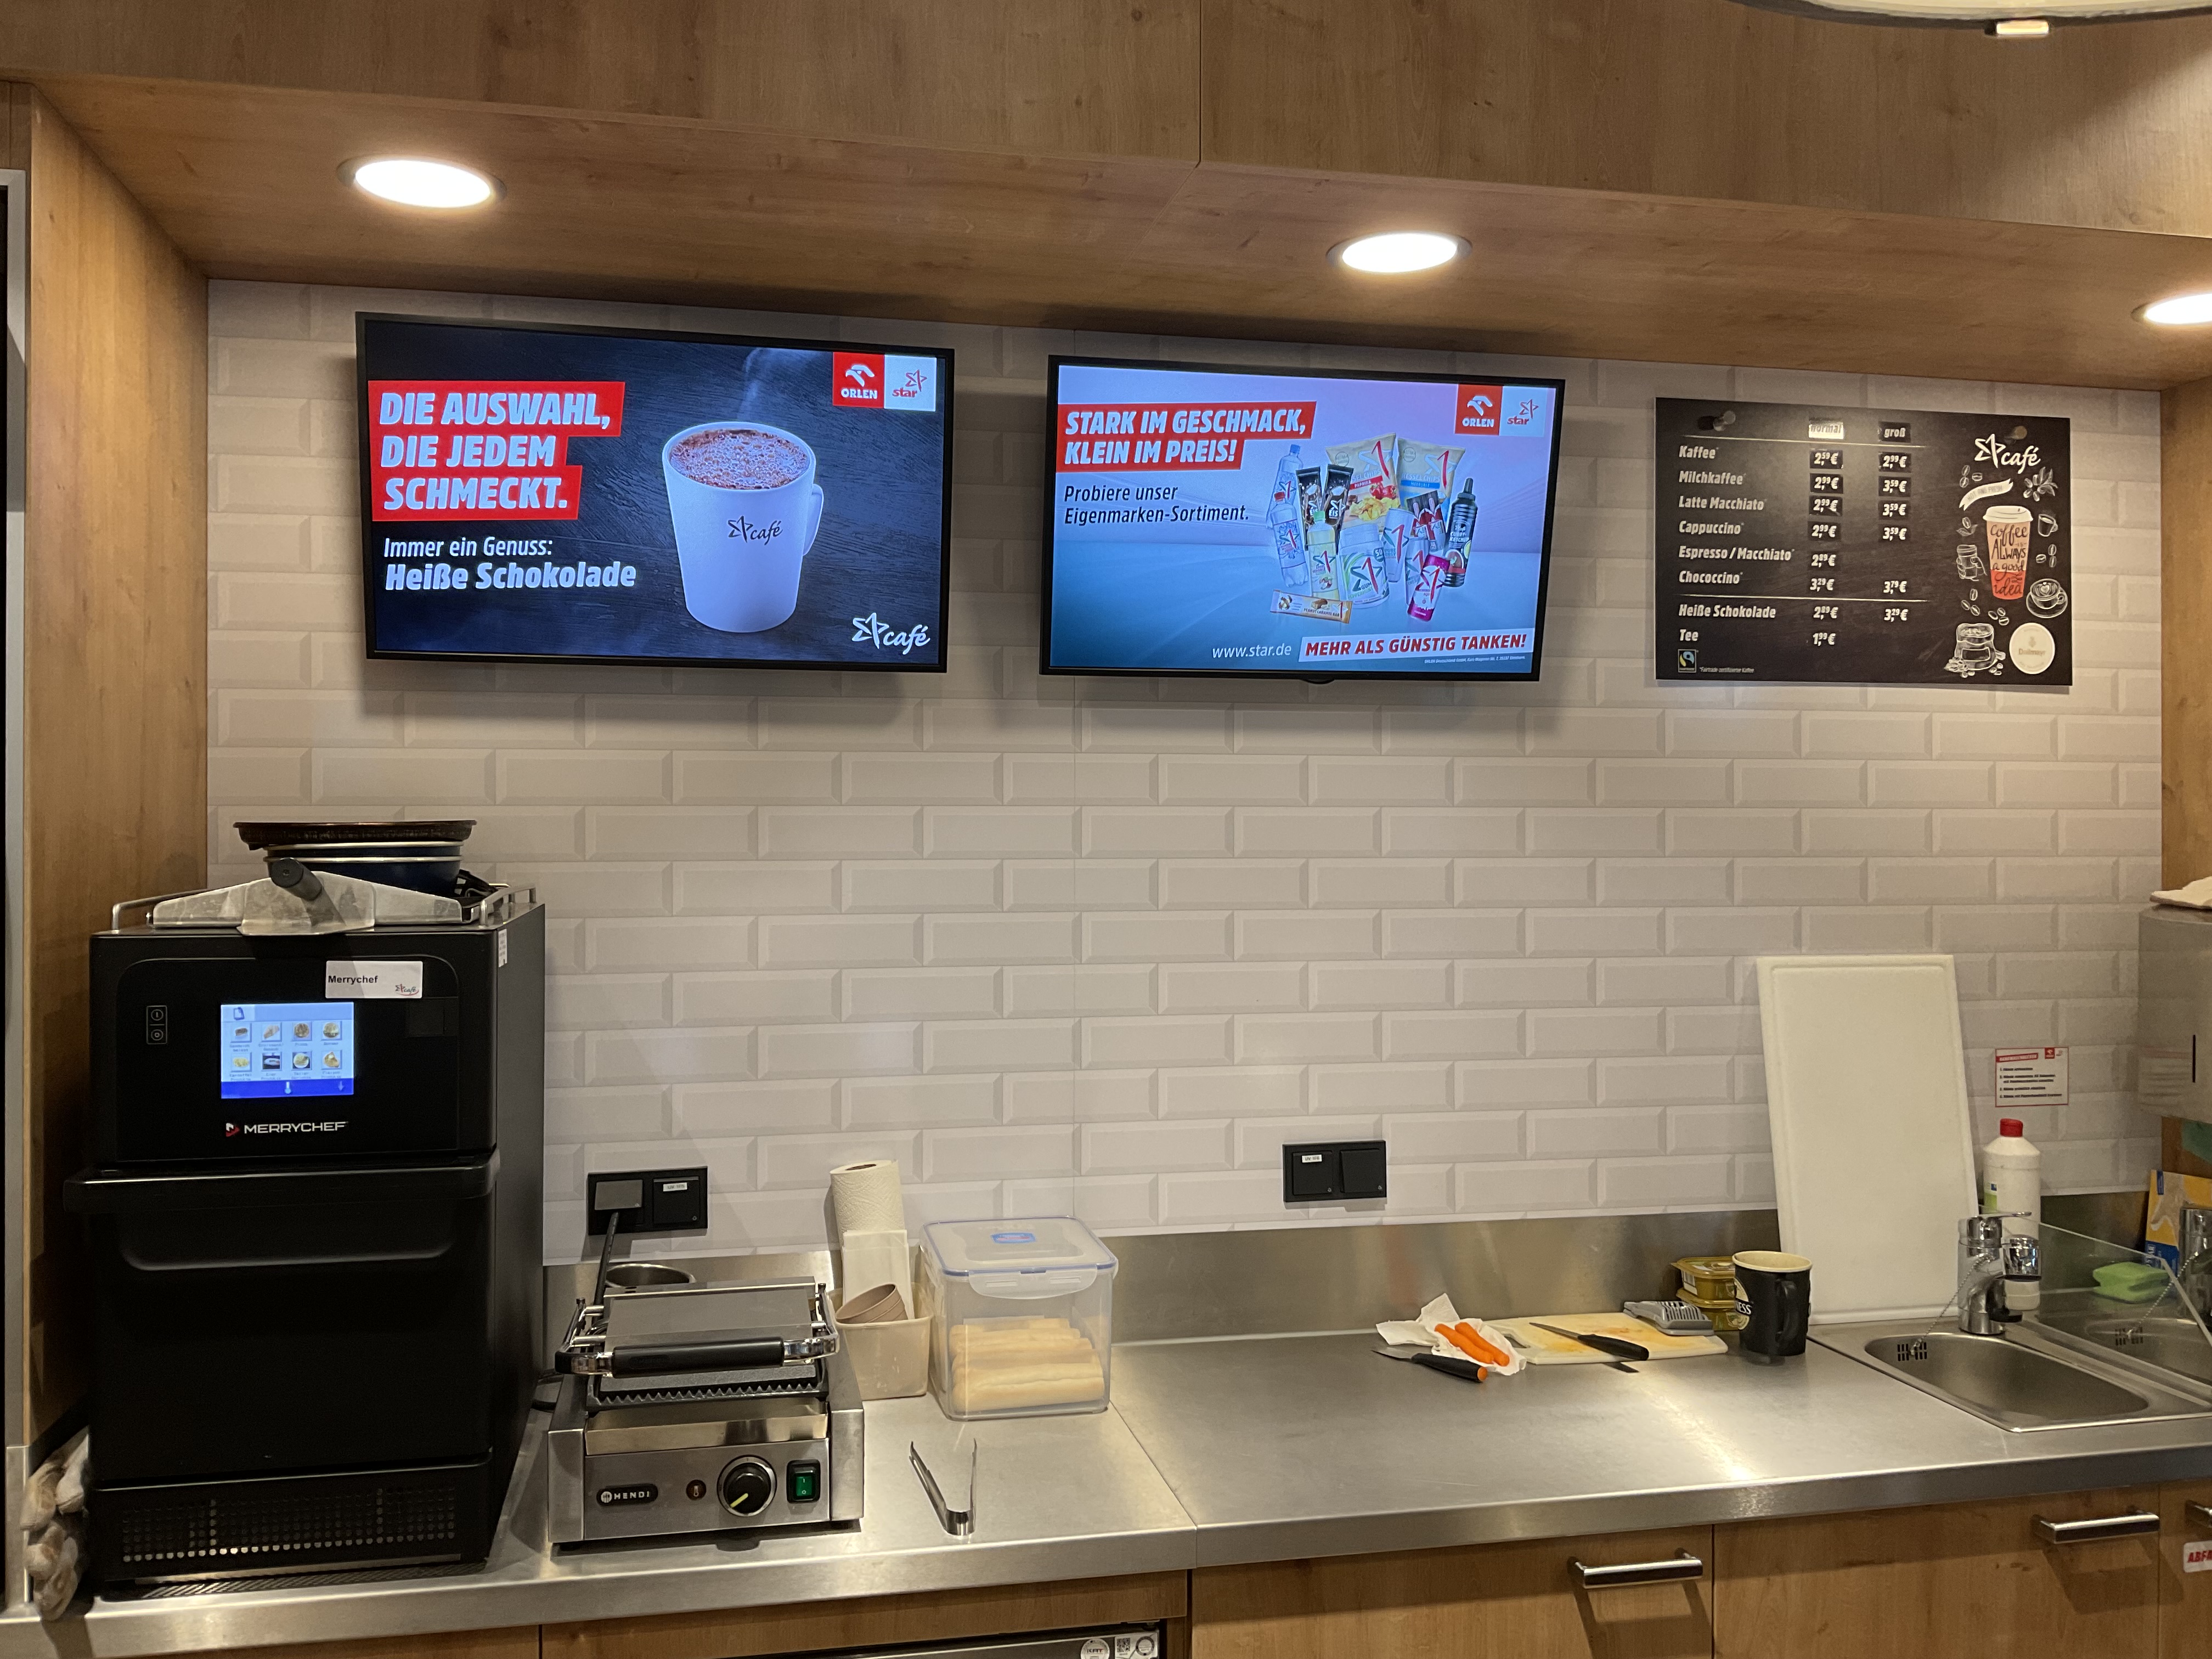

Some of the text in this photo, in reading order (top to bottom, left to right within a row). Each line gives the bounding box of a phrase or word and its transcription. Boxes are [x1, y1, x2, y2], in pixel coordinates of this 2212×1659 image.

[841, 388, 877, 399] ORLEN
[893, 387, 918, 398] star
[380, 393, 611, 429] DIE AUSWAHL,
[1065, 409, 1306, 435] STARK IM GESCHMACK,
[1462, 418, 1494, 427] ORLEN
[1507, 416, 1529, 425] star
[1810, 424, 1842, 433] normal
[1884, 428, 1906, 438] groß
[381, 436, 556, 467] DIE JEDEM
[1065, 439, 1237, 464] KLEIN IM PREIS!
[2001, 445, 2041, 474] café
[383, 477, 568, 510] SCHMECKT.
[1064, 486, 1178, 503] Probiere unser
[1679, 496, 1708, 508] Latte
[1064, 505, 1249, 527] Eigenmarken-Sortiment.
[751, 521, 783, 545] café
[384, 537, 553, 557] Immer ein Genuss:
[1679, 546, 1728, 560] Espresso
[385, 561, 636, 590] Heiße Schokolade
[1679, 605, 1776, 618] Heiße Schokolade
[884, 625, 930, 654] café
[1679, 629, 1699, 641] Tee
[1212, 643, 1291, 658] www.star.de
[1305, 634, 1526, 656] MEHR ALS GÜNSTIG TANKEN!
[328, 975, 378, 985] Merrychef
[244, 1121, 346, 1134] MERRYCHEF
[614, 1491, 650, 1500] HENDI
